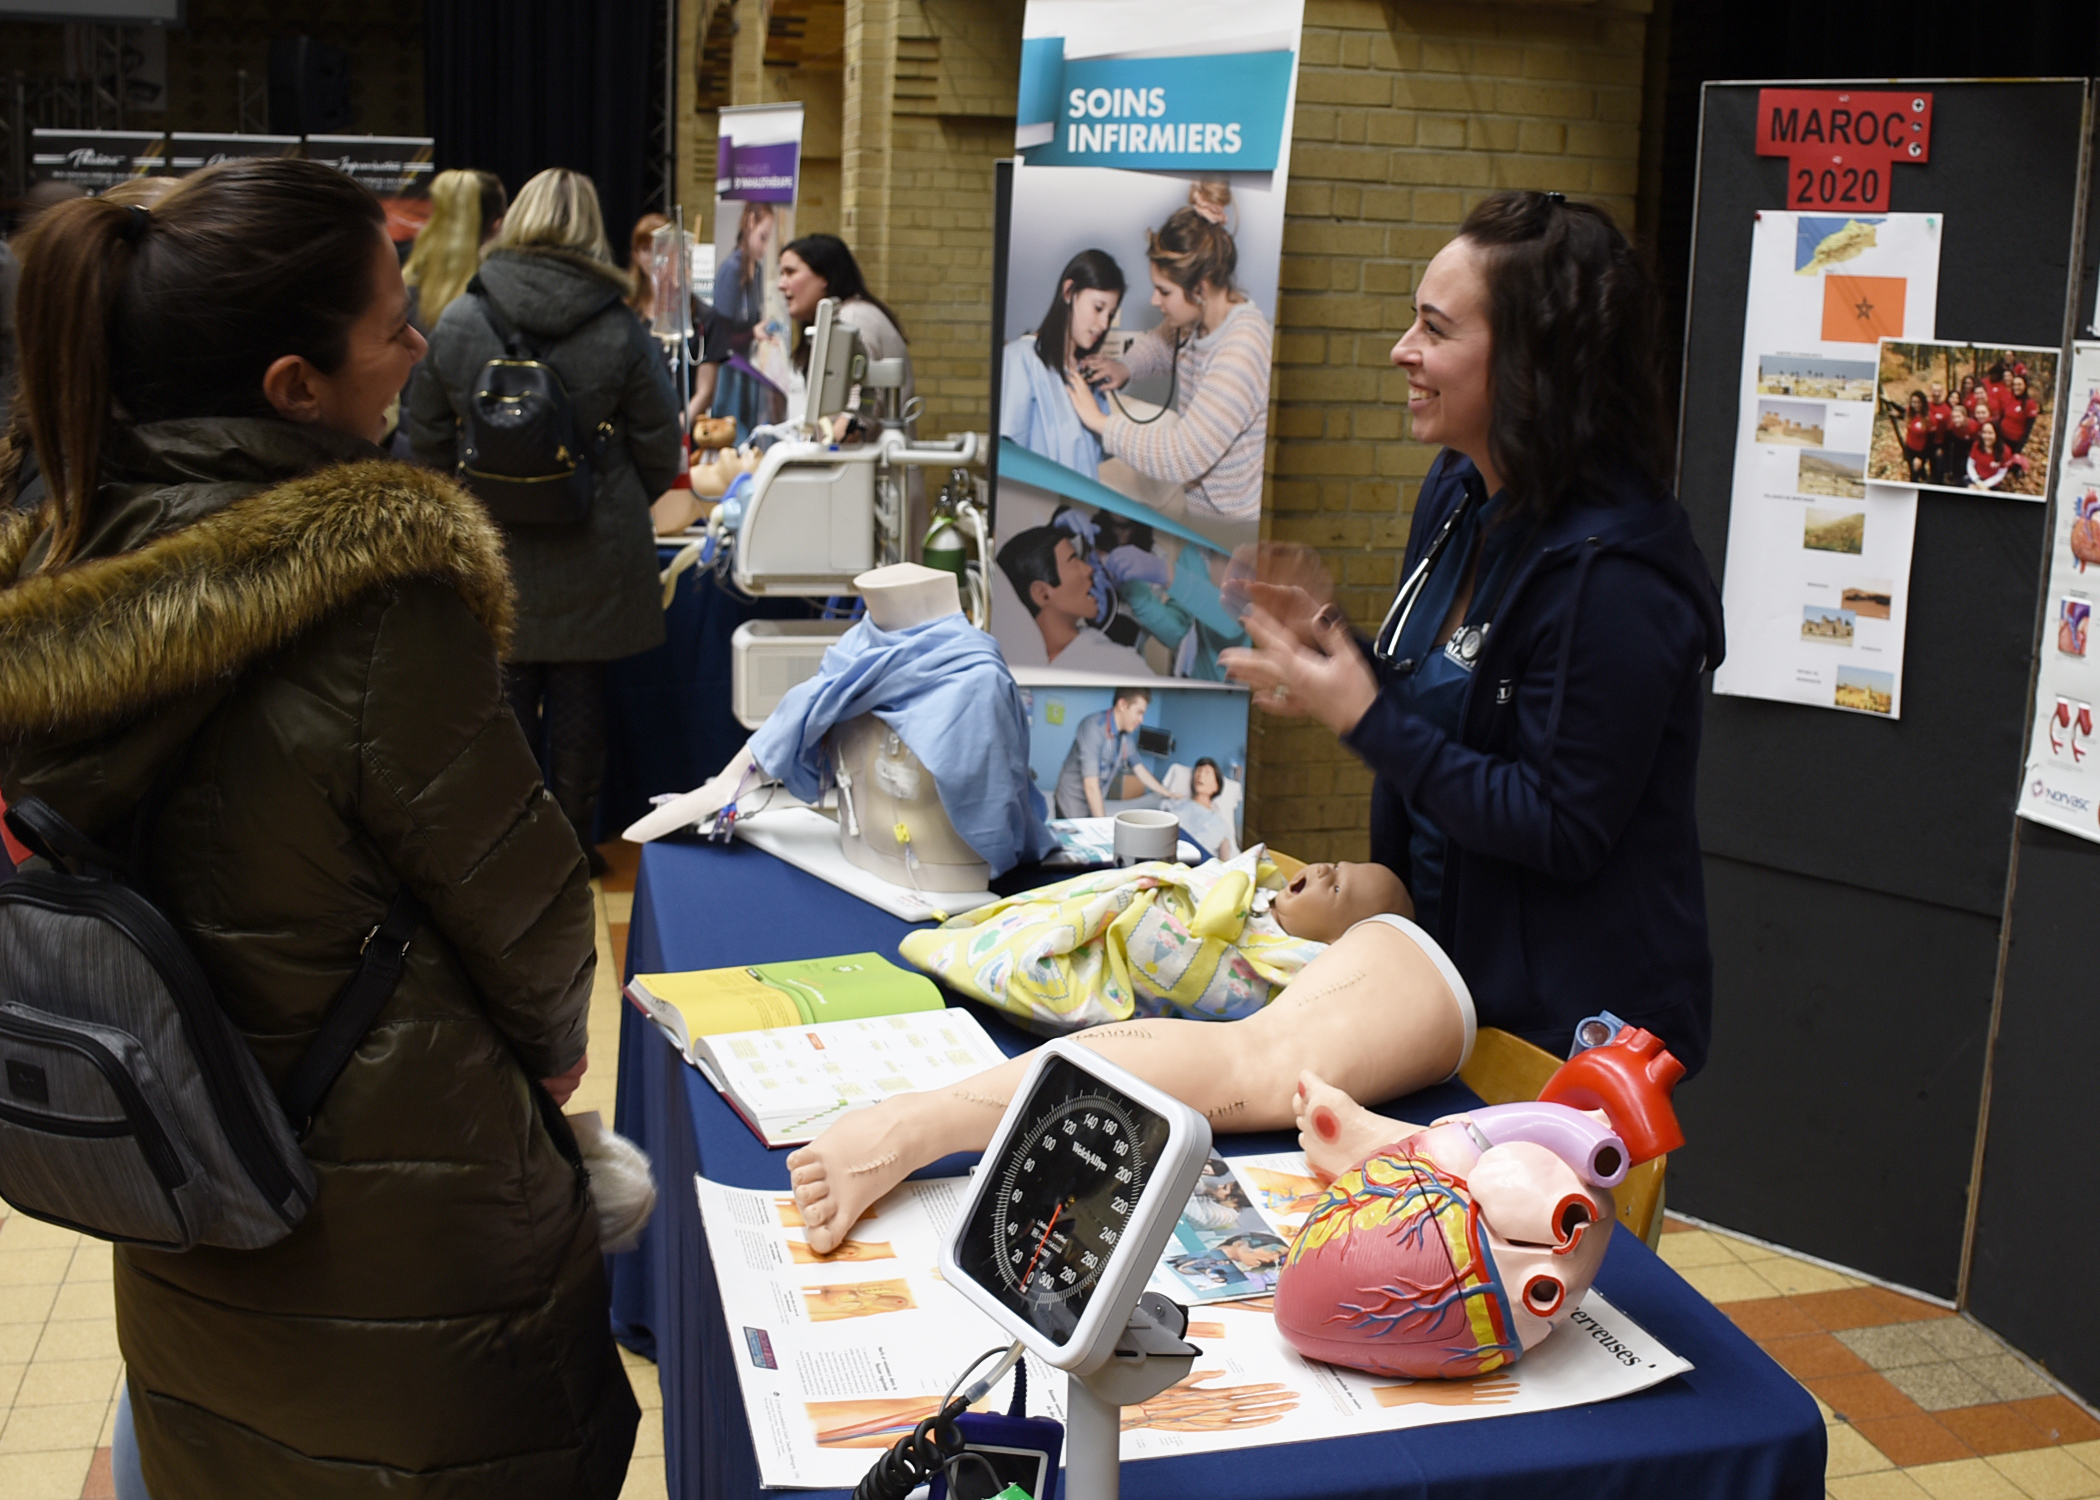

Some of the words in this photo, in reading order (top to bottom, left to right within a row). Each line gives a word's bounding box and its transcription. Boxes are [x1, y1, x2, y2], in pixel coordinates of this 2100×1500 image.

[1068, 87, 1166, 118] SOINS
[1770, 107, 1906, 148] MAROC
[1067, 122, 1242, 153] INFIRMIERS
[1796, 168, 1879, 203] 2020
[1063, 1120, 1076, 1135] 120
[1084, 1113, 1098, 1129] 140
[1103, 1119, 1117, 1135] 160
[1043, 1136, 1056, 1150] 100
[1113, 1140, 1128, 1156] 180
[1024, 1159, 1035, 1172] 80
[1115, 1166, 1132, 1183] 200
[1012, 1189, 1022, 1202] 60
[1111, 1197, 1128, 1214] 220
[1008, 1222, 1018, 1235] 40
[1099, 1227, 1116, 1244] 240
[1012, 1249, 1023, 1263] 20
[1081, 1251, 1098, 1269] 260
[1027, 1272, 1034, 1283] 0
[1039, 1272, 1054, 1289] 300
[1060, 1266, 1076, 1284] 280
